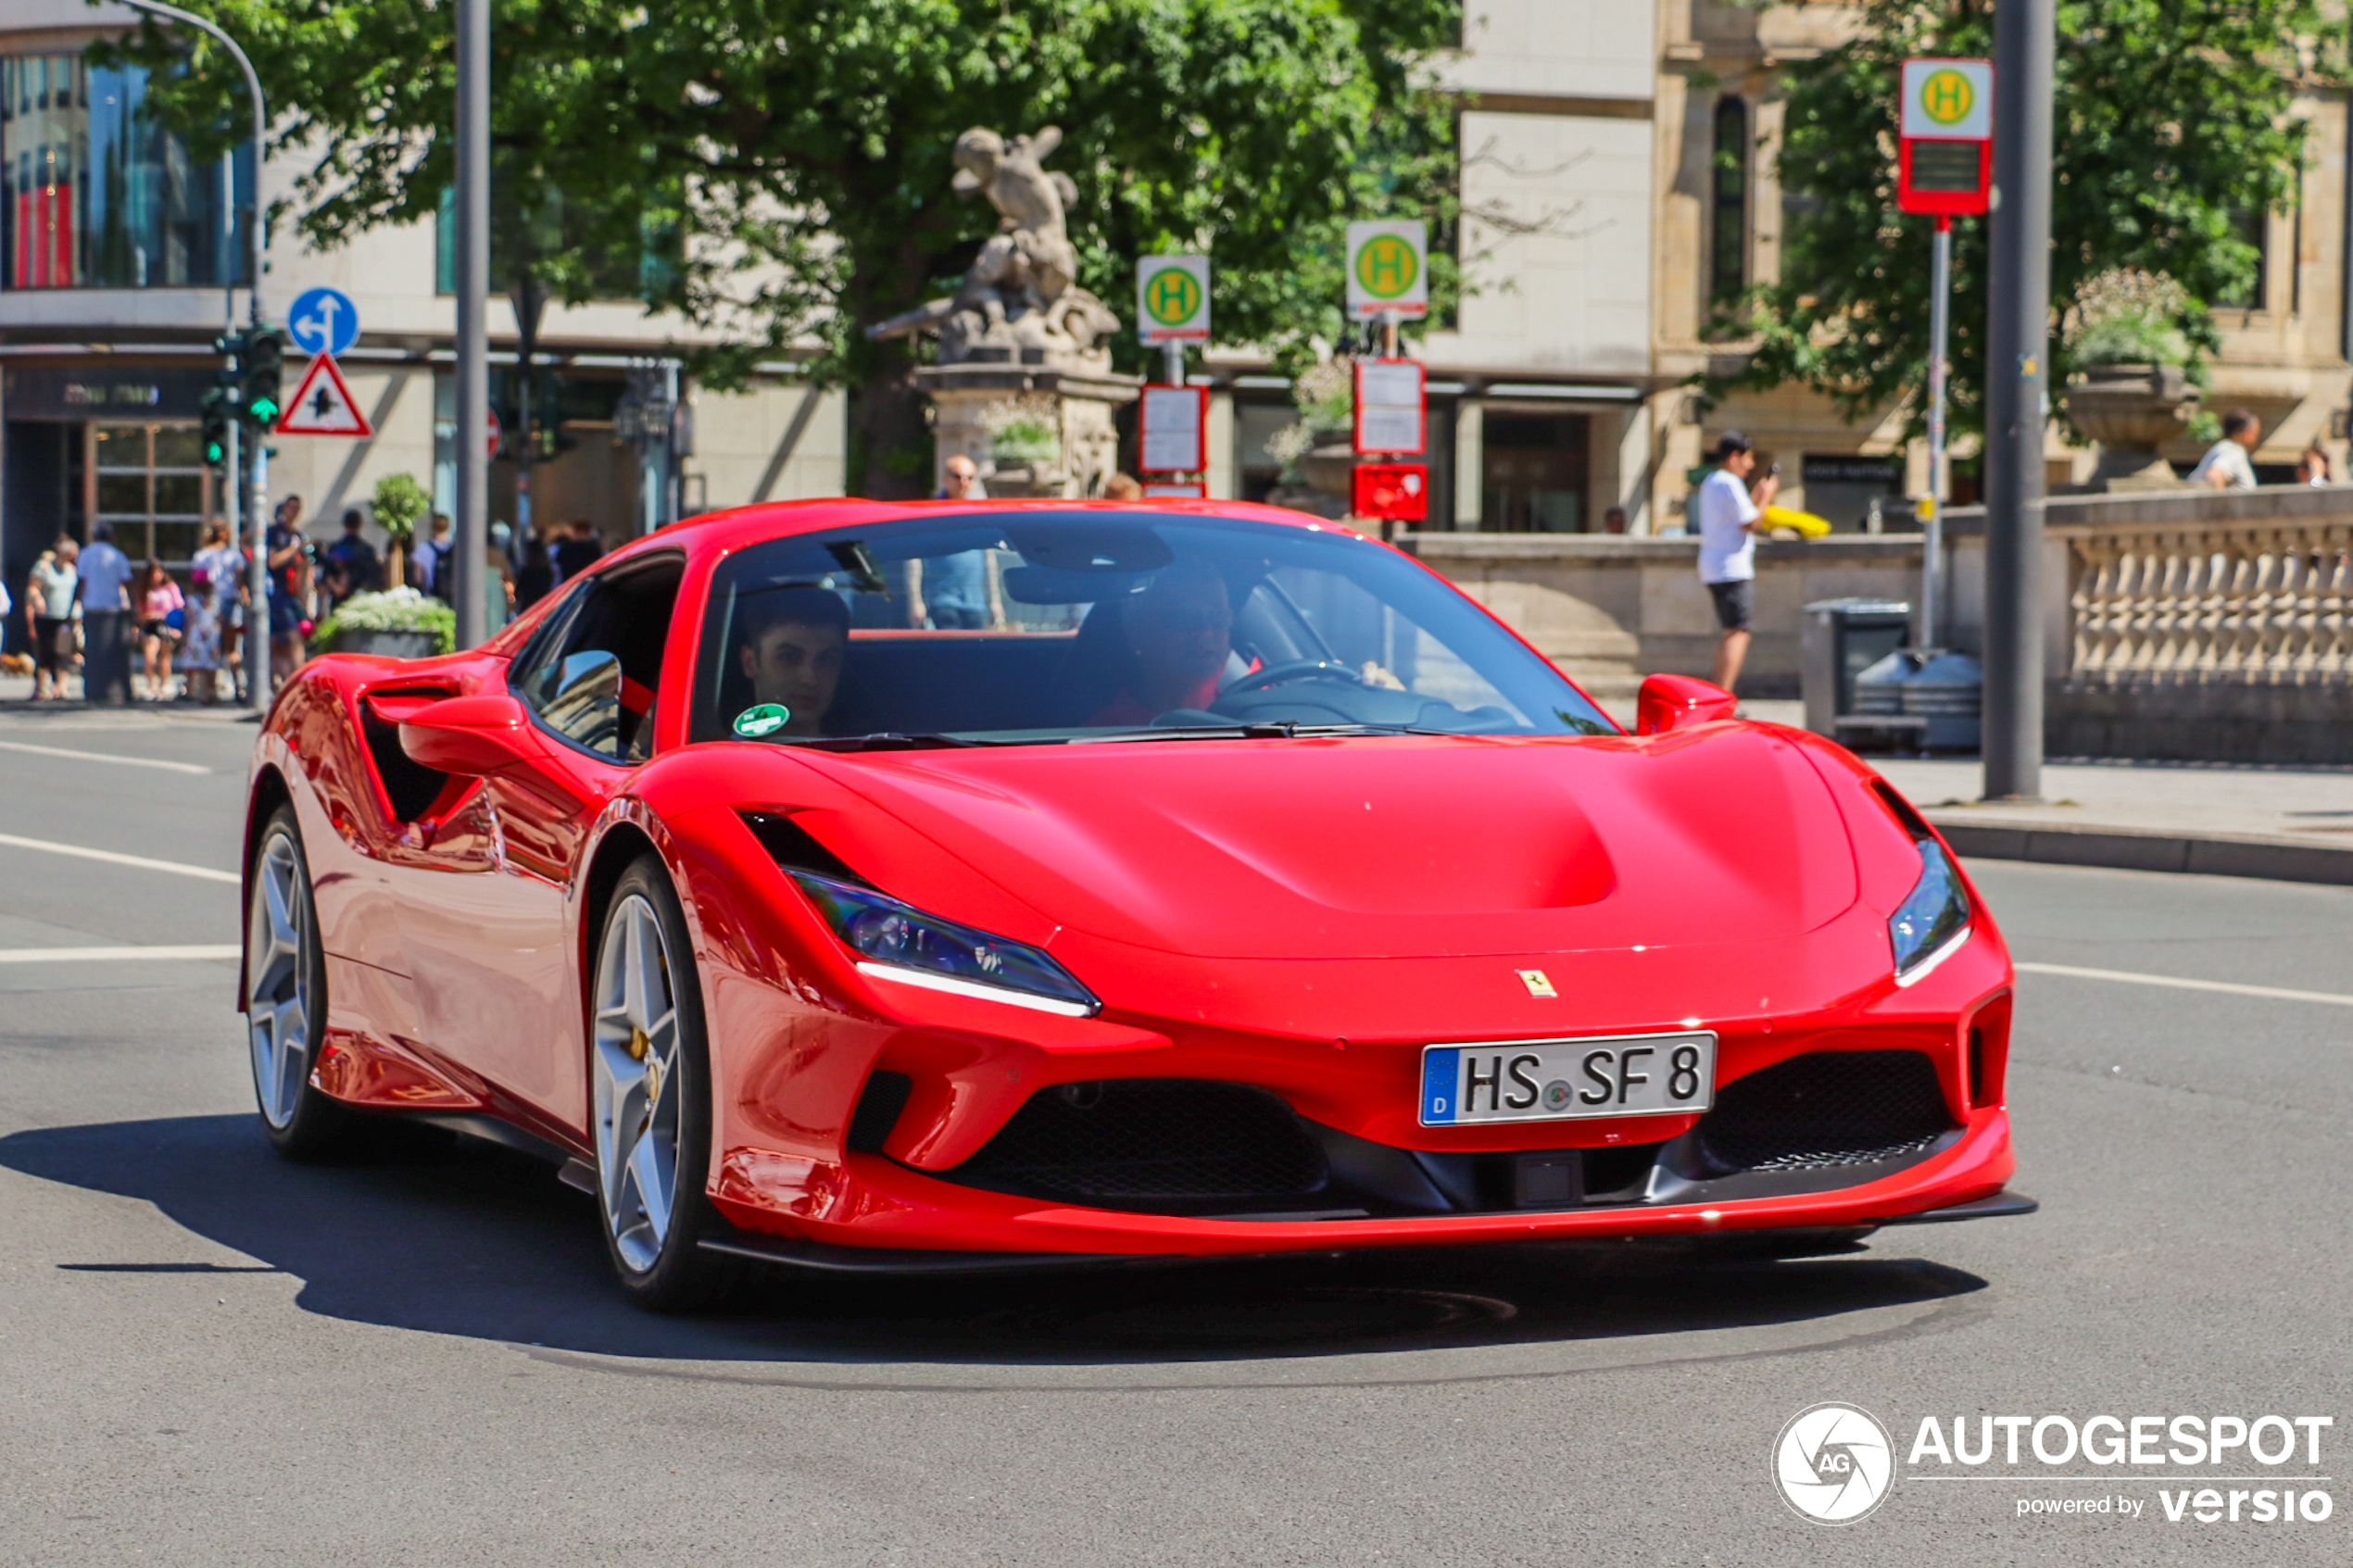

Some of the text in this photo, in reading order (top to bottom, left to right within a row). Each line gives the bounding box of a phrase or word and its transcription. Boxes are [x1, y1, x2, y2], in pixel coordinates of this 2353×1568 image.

[1935, 82, 1960, 112] H
[1373, 247, 1402, 285] H
[1160, 280, 1186, 314] H
[1466, 1045, 1700, 1111] HS SF 8
[1433, 1098, 1447, 1114] D
